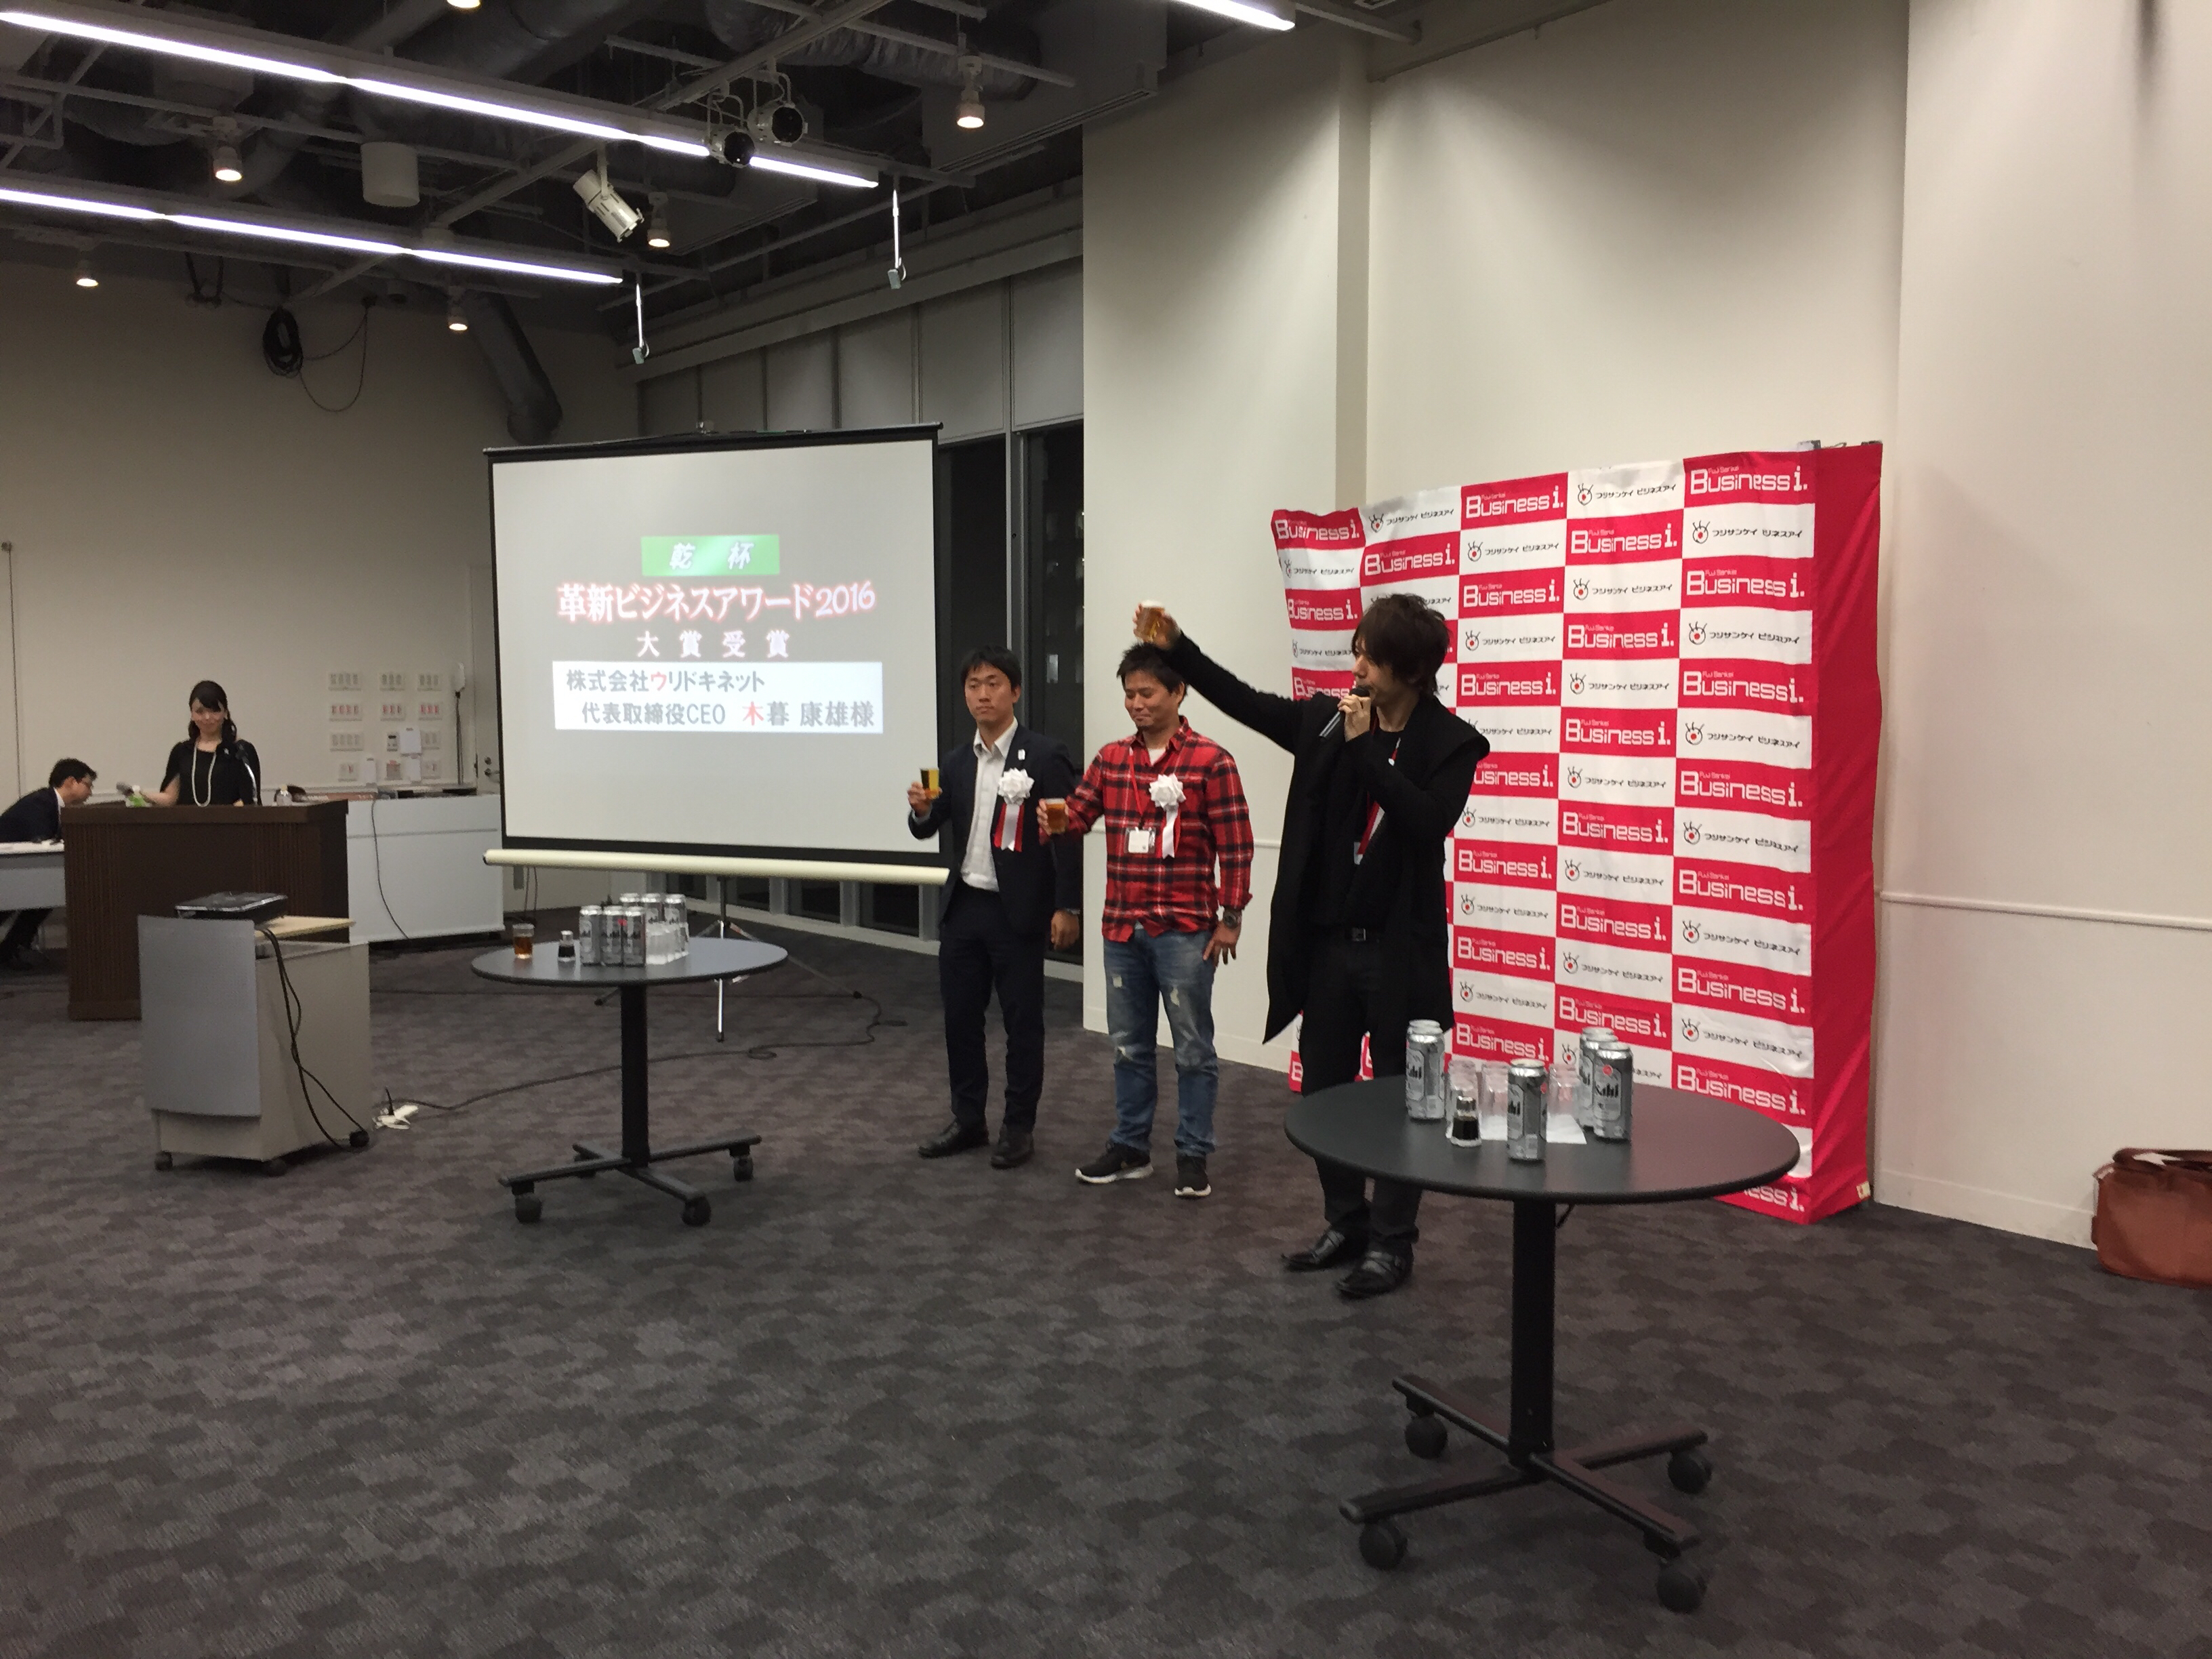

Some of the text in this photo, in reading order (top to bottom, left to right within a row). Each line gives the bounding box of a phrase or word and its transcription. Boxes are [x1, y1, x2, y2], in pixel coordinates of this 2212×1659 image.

[1689, 466, 1790, 494] Business
[1465, 493, 1550, 518] Business
[1275, 518, 1350, 540] Business
[1570, 529, 1662, 553] Business
[1364, 551, 1443, 575] Business
[1463, 584, 1547, 607] Business
[1685, 569, 1786, 596] Business
[557, 581, 876, 621] 革新ビジネスアワード2016
[1568, 624, 1658, 648] Business
[567, 669, 765, 693] 株式会社ウリドキネット
[1460, 673, 1543, 695] Business
[1683, 670, 1788, 701] Business
[581, 701, 726, 725] 代表取締役CEO
[1565, 718, 1654, 745] Business
[1473, 771, 1540, 786] usiness
[1680, 771, 1786, 804] Business
[1562, 811, 1653, 842] Business
[1458, 849, 1538, 877] Business
[1679, 869, 1786, 907] Business
[1561, 903, 1652, 939] Business
[1457, 936, 1537, 968] Business
[1677, 967, 1786, 1009] Business
[1559, 996, 1651, 1034] Business
[1456, 1023, 1536, 1058] Business
[1677, 1065, 1786, 1110] Business
